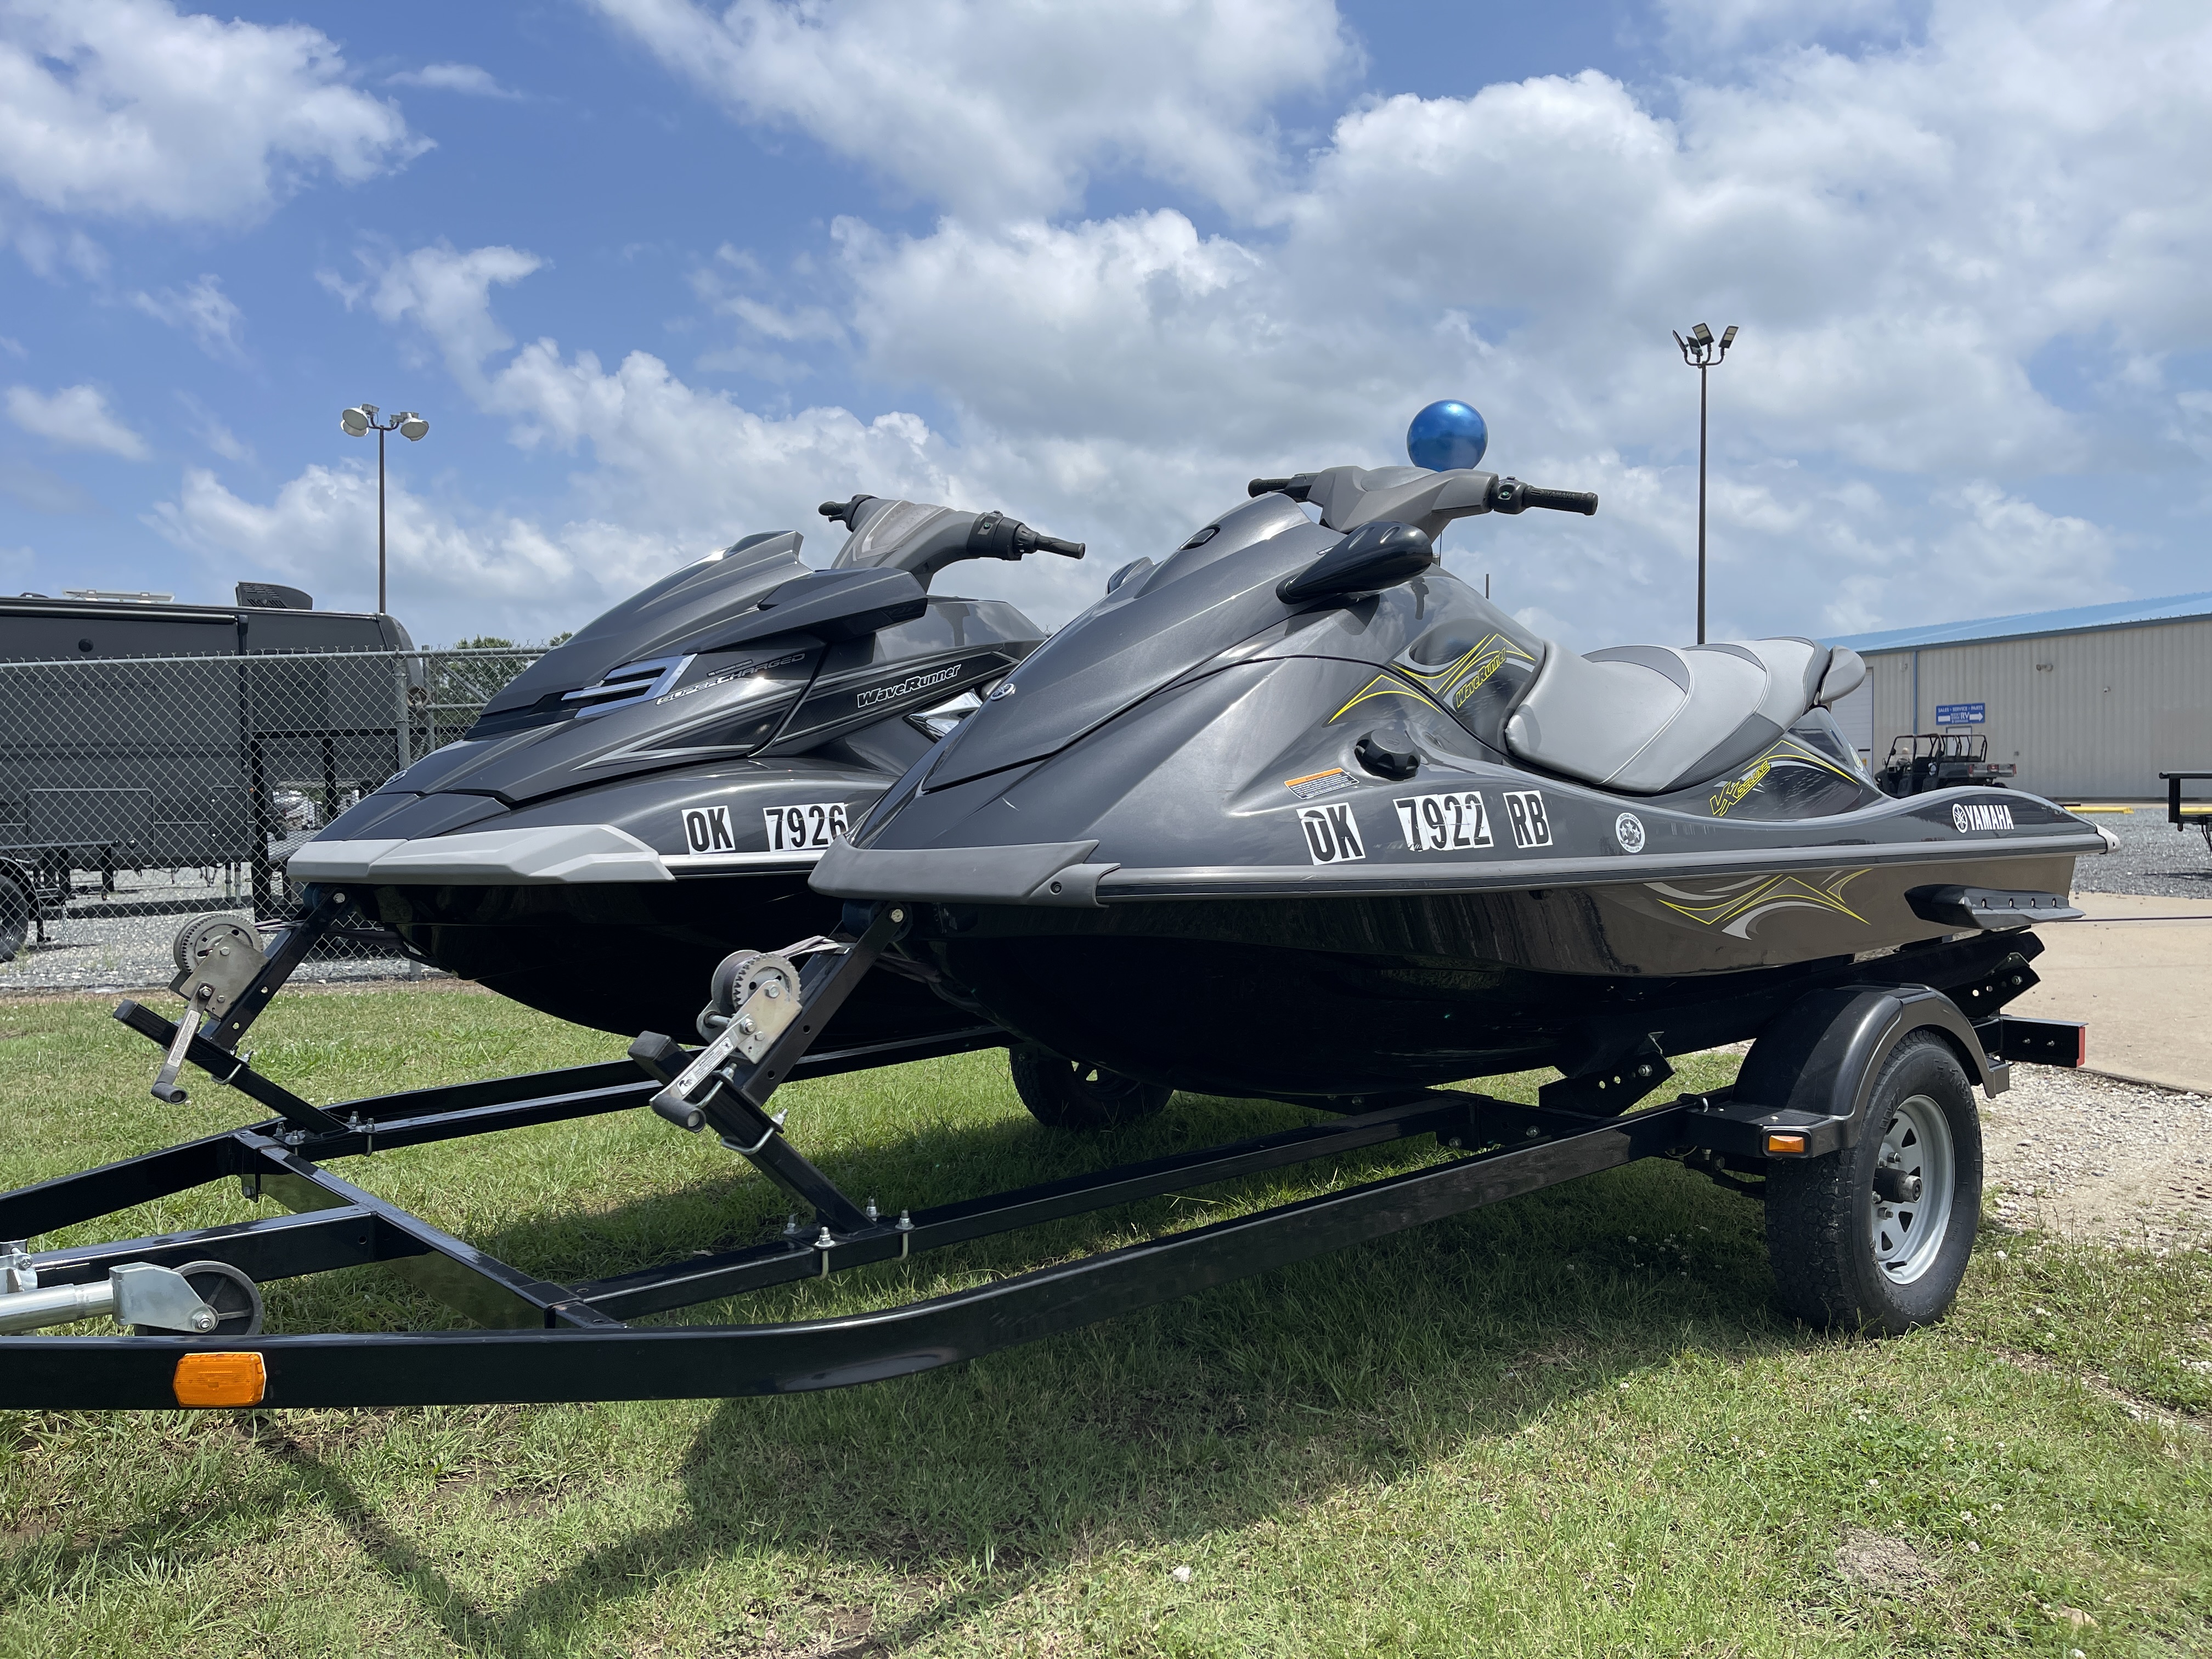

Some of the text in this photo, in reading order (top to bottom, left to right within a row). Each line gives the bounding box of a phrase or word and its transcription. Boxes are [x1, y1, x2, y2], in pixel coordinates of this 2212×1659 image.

[656, 653, 805, 706] SUPERCHARGED
[857, 664, 962, 708] WaveRunner
[1456, 646, 1506, 708] WaveRunner
[1737, 760, 1770, 798] DELUXE
[686, 805, 847, 851] OK 7926
[1302, 794, 1549, 862] OK 7922 RB
[1964, 805, 2014, 831] YAMAHA
